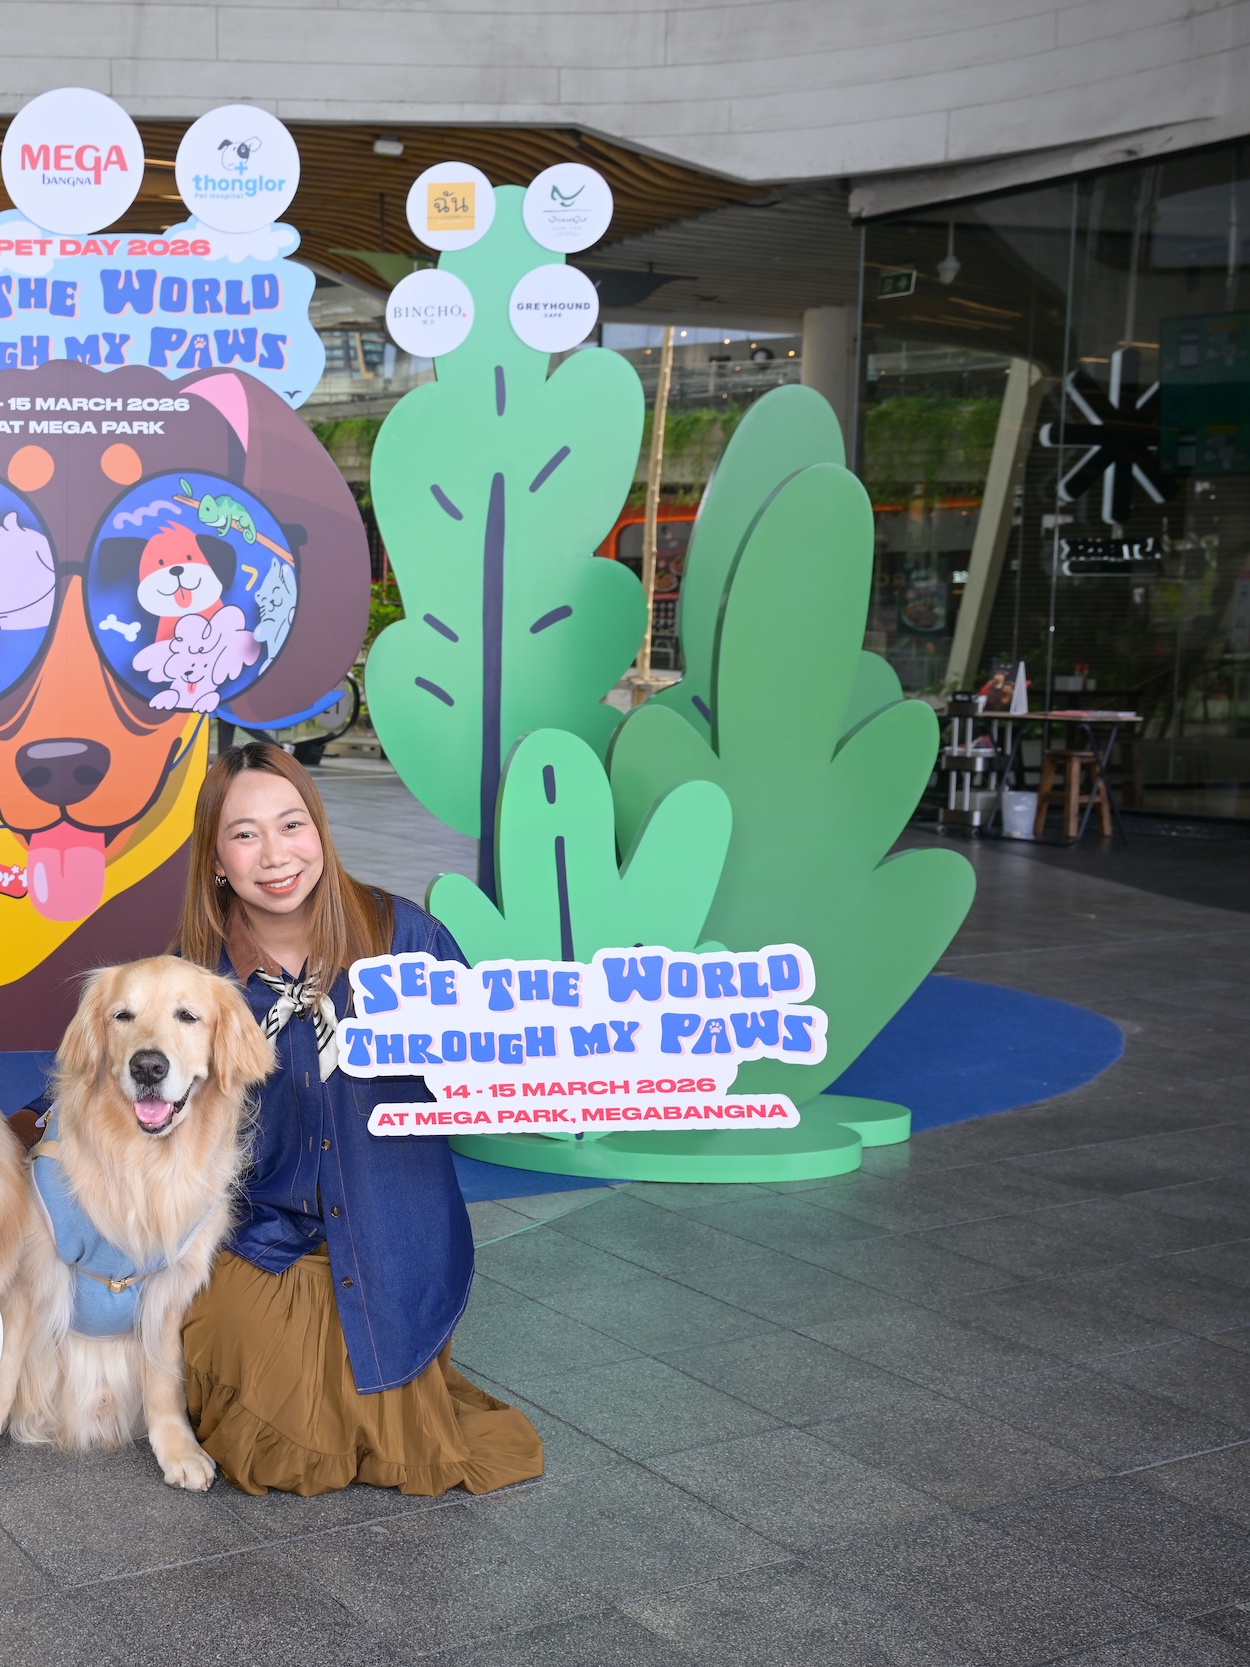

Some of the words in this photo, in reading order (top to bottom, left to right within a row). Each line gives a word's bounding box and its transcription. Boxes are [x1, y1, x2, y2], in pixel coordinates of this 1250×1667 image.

[20, 144, 129, 185] MEGA
[192, 173, 286, 197] thonglor
[433, 191, 469, 213] ฉัน
[59, 239, 123, 256] DAY
[127, 239, 211, 256] 2026
[100, 269, 282, 317] WORLD
[393, 305, 463, 319] BINCHO
[516, 302, 591, 311] GREYHOUND
[64, 333, 134, 367] MY
[147, 326, 289, 373] PAWS
[8, 397, 31, 411] 15
[35, 397, 124, 411] MARCH
[127, 397, 190, 412] 2026
[29, 420, 92, 435] MEGA
[95, 420, 165, 435] PARK
[357, 961, 459, 1016] SEE
[482, 968, 582, 1013] THE
[602, 953, 804, 1004] WORLD
[345, 1025, 558, 1067] THROUGH
[569, 1020, 643, 1058] MY
[660, 1009, 815, 1057] PAWS
[442, 1084, 472, 1100] 14
[488, 1083, 517, 1098] 15
[522, 1080, 631, 1097] MARCH
[635, 1077, 716, 1094] 2026
[377, 1112, 410, 1127] AT
[415, 1110, 493, 1126] MEGA
[497, 1108, 578, 1124] PARK,
[582, 1104, 789, 1123] MEGABANGNA
